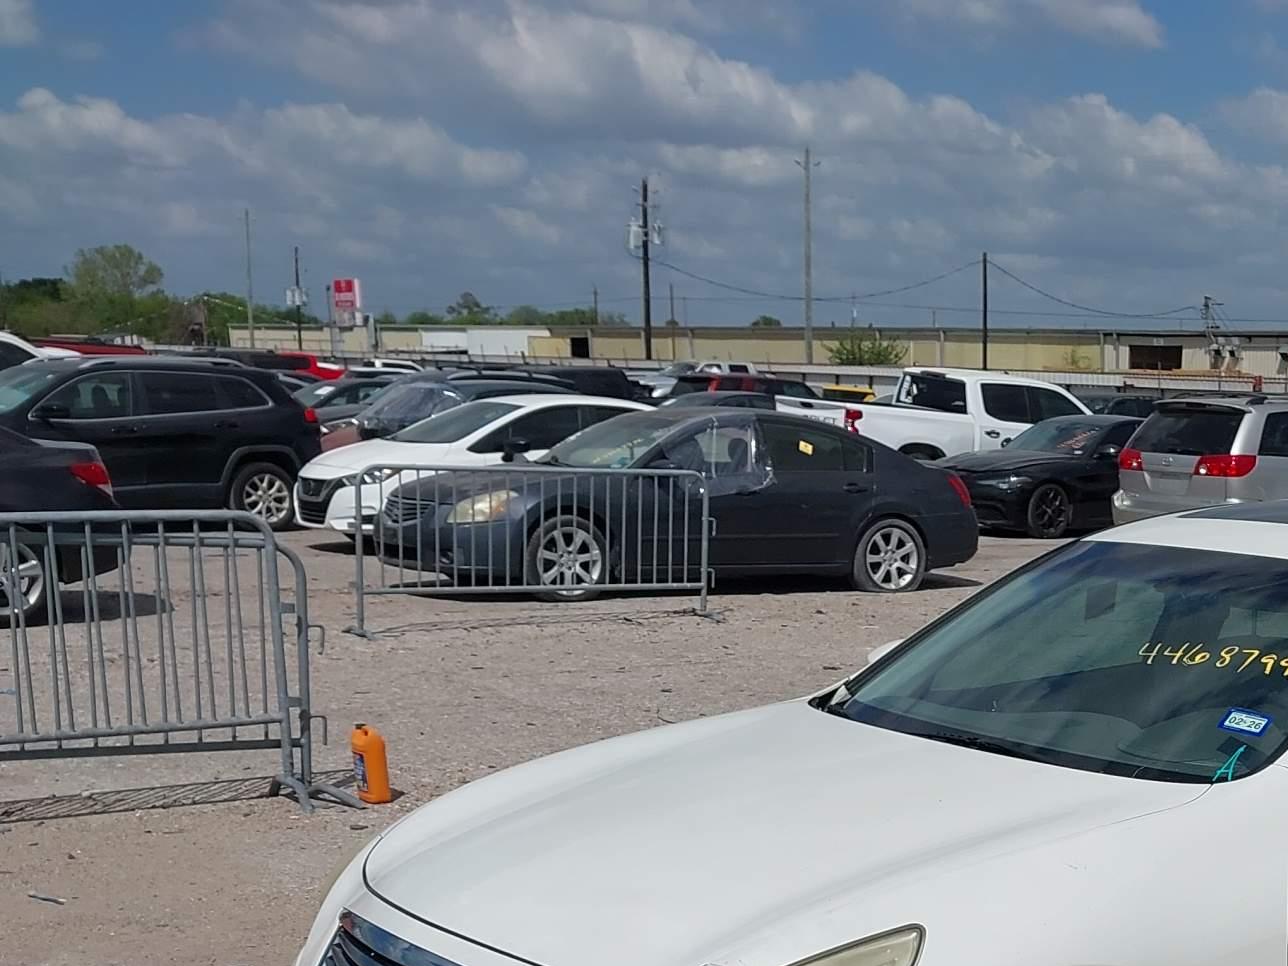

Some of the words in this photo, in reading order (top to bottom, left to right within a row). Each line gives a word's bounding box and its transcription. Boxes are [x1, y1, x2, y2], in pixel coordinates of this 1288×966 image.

[1228, 716, 1244, 726] 02
[1249, 720, 1263, 730] 26
[1213, 744, 1247, 782] A
